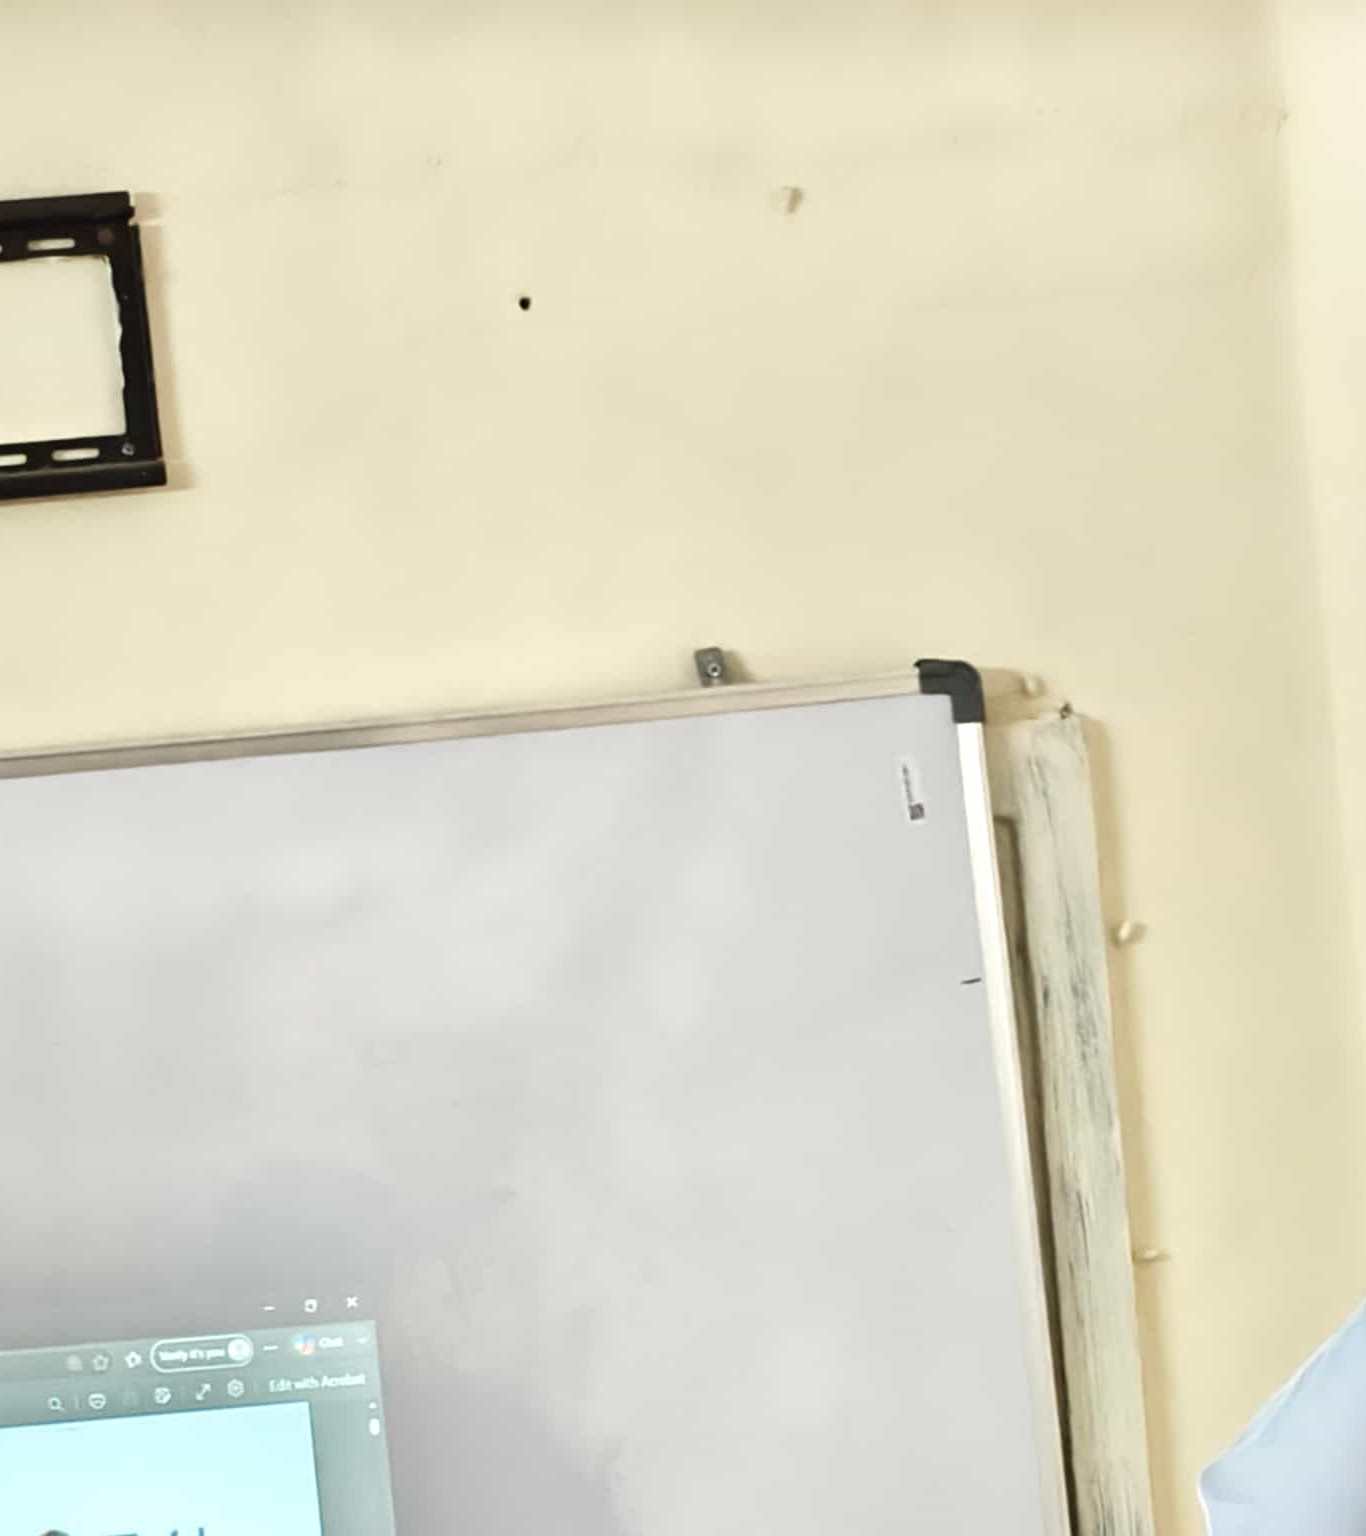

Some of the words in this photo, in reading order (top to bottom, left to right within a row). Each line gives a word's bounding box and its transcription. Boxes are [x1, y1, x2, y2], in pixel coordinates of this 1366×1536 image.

[269, 1379, 292, 1392] Edit
[294, 1376, 320, 1390] with
[322, 1373, 366, 1388] Acrobat
